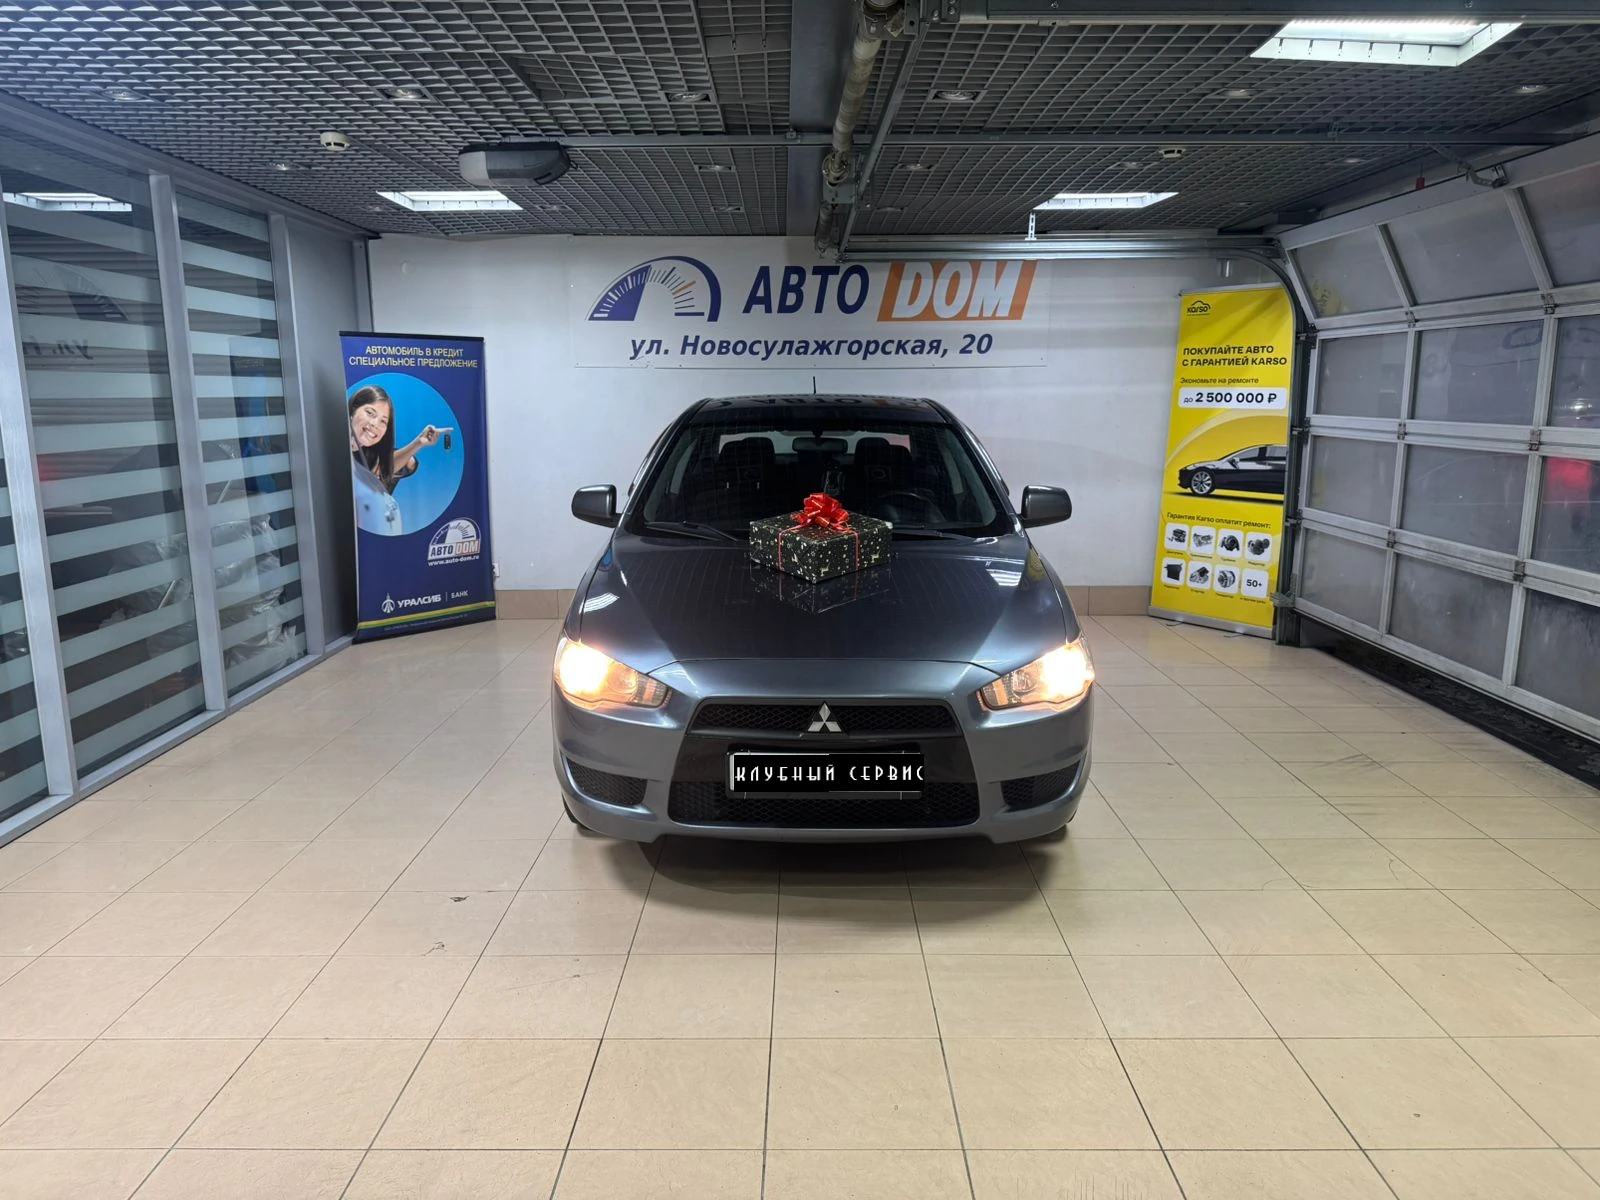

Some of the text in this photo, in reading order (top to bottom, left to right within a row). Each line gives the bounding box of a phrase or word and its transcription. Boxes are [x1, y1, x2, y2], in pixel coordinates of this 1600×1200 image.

[742, 260, 1024, 319] АВТО DOM
[365, 345, 464, 359] АВТОМОБИЛЬ В КРЕДИТ
[629, 333, 994, 360] ул. Новосулажгорская, 20
[1183, 345, 1274, 356] ПОКУПАЙТЕ АВТО
[348, 356, 478, 369] СПЕЦИАЛЬНОЕ ПРЕДЛОЖЕНИЕ
[1182, 356, 1287, 367] С ГАРАНТИЕЙ KARSO
[1195, 392, 1203, 403] 2
[1206, 392, 1233, 403] 500
[1236, 392, 1264, 403] 000
[1267, 392, 1277, 404] ₽
[1166, 512, 1271, 529] Гарантия Karso оплатит ремонт:
[430, 540, 479, 557] АВТО DOM
[428, 555, 480, 566] www.auto-dom.ru
[1246, 579, 1263, 588] 50+
[397, 590, 469, 608] УРАЛСИБ БАНК
